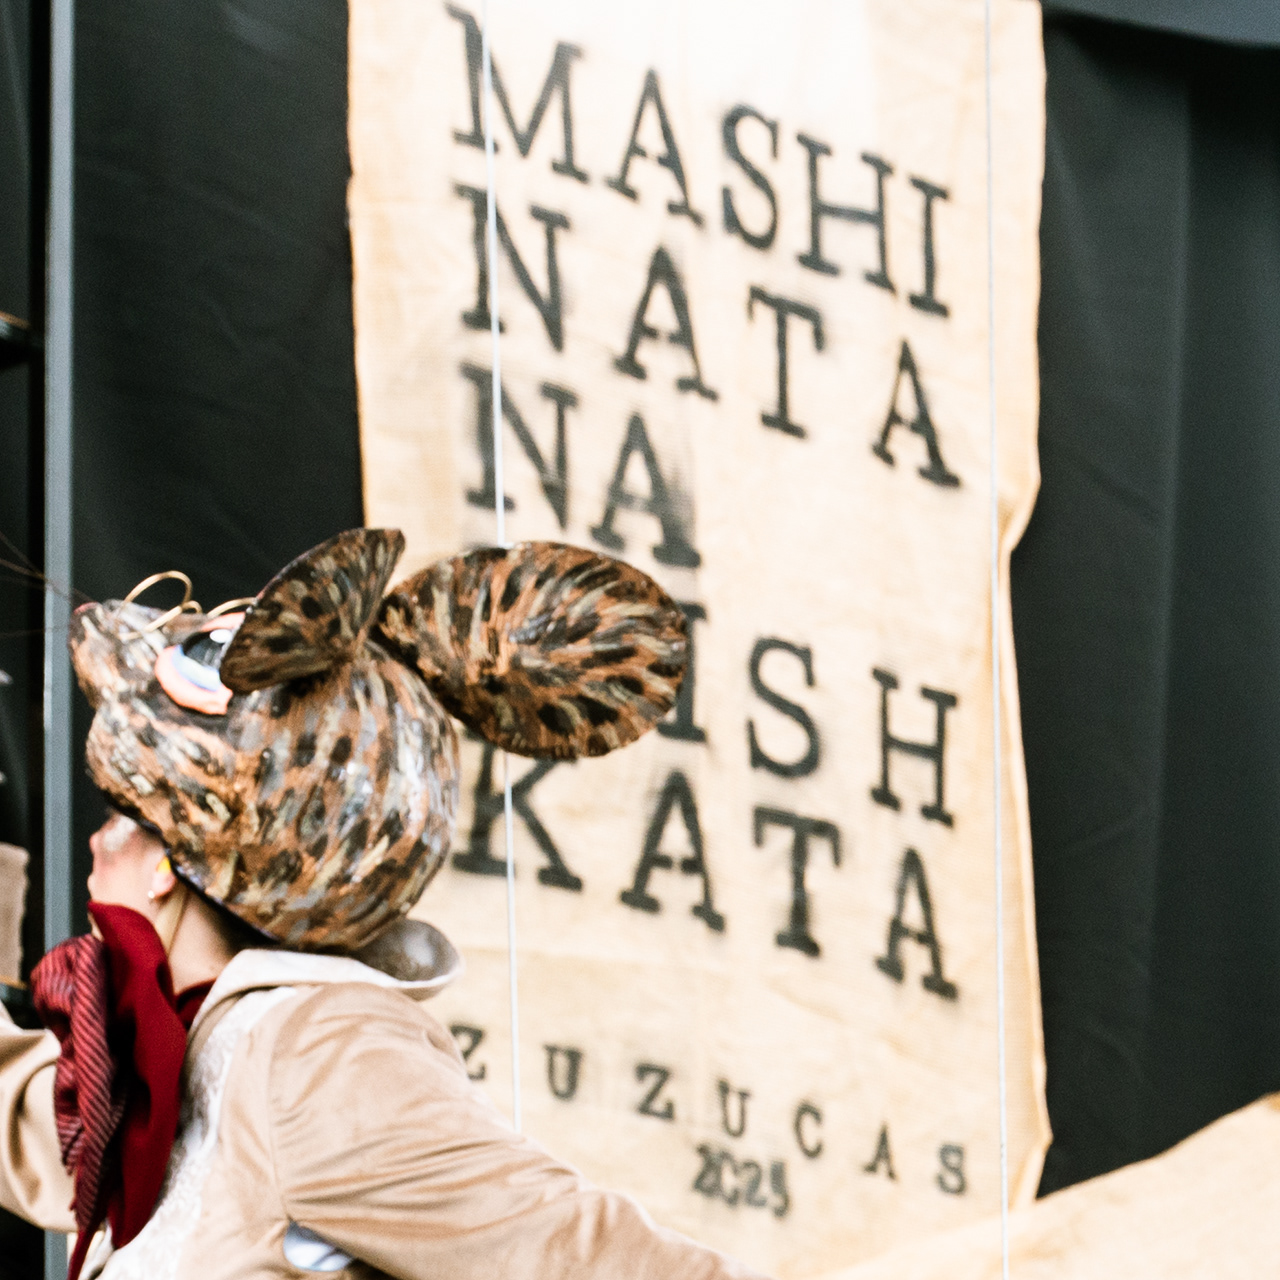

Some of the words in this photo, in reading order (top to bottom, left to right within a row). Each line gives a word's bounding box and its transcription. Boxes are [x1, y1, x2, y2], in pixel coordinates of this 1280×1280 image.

[444, 2, 952, 319] MASHI
[452, 180, 962, 489] NATA
[460, 361, 704, 570] NA
[660, 602, 958, 834] ISH
[452, 728, 960, 1000] KATA
[449, 1022, 970, 1198] ZUZUCAS
